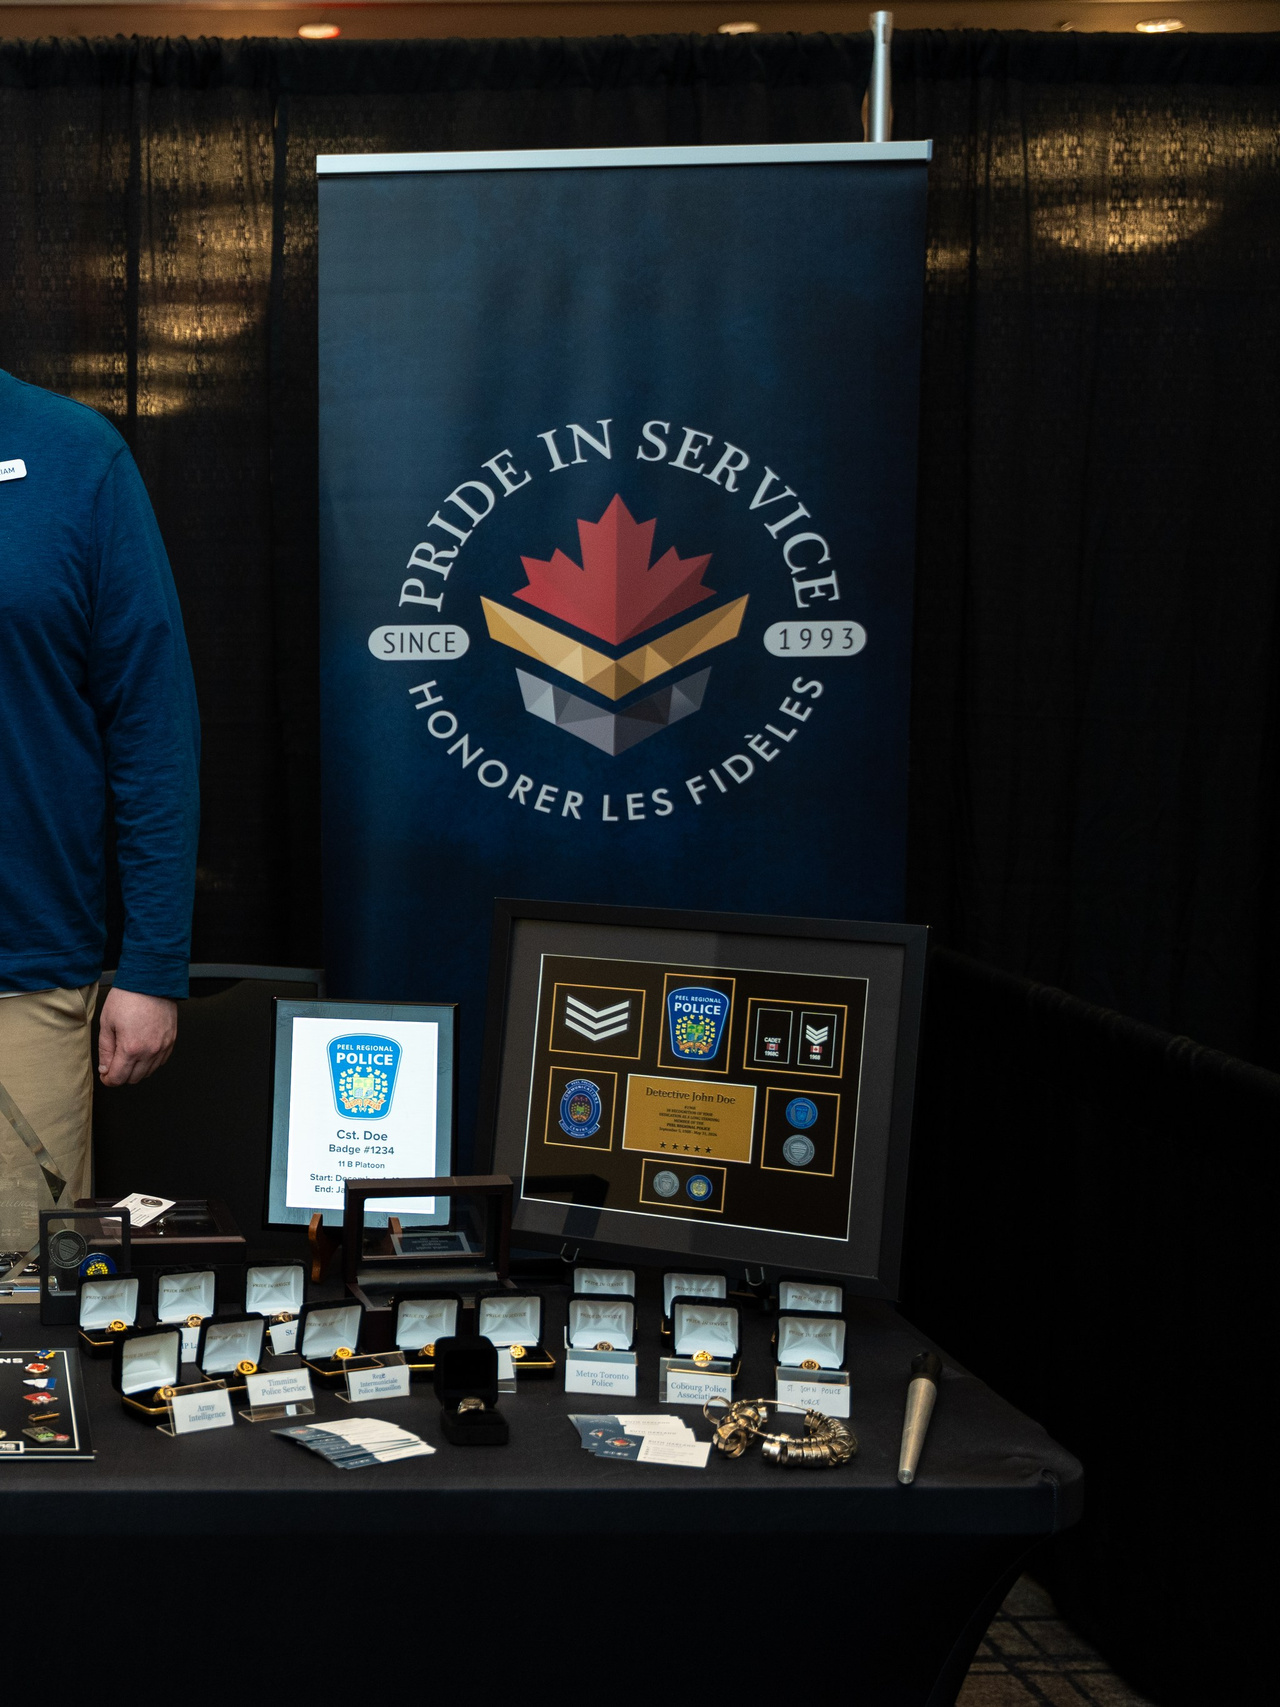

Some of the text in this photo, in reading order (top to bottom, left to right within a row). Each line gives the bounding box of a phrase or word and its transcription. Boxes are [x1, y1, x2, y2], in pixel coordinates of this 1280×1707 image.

[398, 418, 840, 612] PRIDE IN SERVICE
[383, 631, 456, 654] SINCE
[779, 627, 855, 651] 1993
[408, 675, 825, 822] HONORER LES FIDÈLES
[690, 996, 722, 1004] REGIONAL
[674, 1002, 721, 1015] POLICE
[356, 1044, 394, 1052] REGIONAL
[336, 1052, 394, 1066] POLICE
[645, 1087, 736, 1105] Detective John Doe
[336, 1129, 388, 1142] Cst. Doe
[328, 1144, 395, 1156] Badge #1234
[355, 1161, 386, 1169] Platoon
[310, 1173, 333, 1182] Start:
[314, 1185, 334, 1193] End:
[575, 1370, 629, 1380] Metro Toronto
[267, 1377, 298, 1388] Timmins
[591, 1379, 614, 1388] Police
[670, 1382, 727, 1393] Cobourg Police
[261, 1383, 307, 1397] Police Service
[800, 1385, 817, 1393] JOHN
[677, 1391, 714, 1400] Associati
[197, 1403, 216, 1413] Army
[188, 1410, 226, 1423] Intelligence
